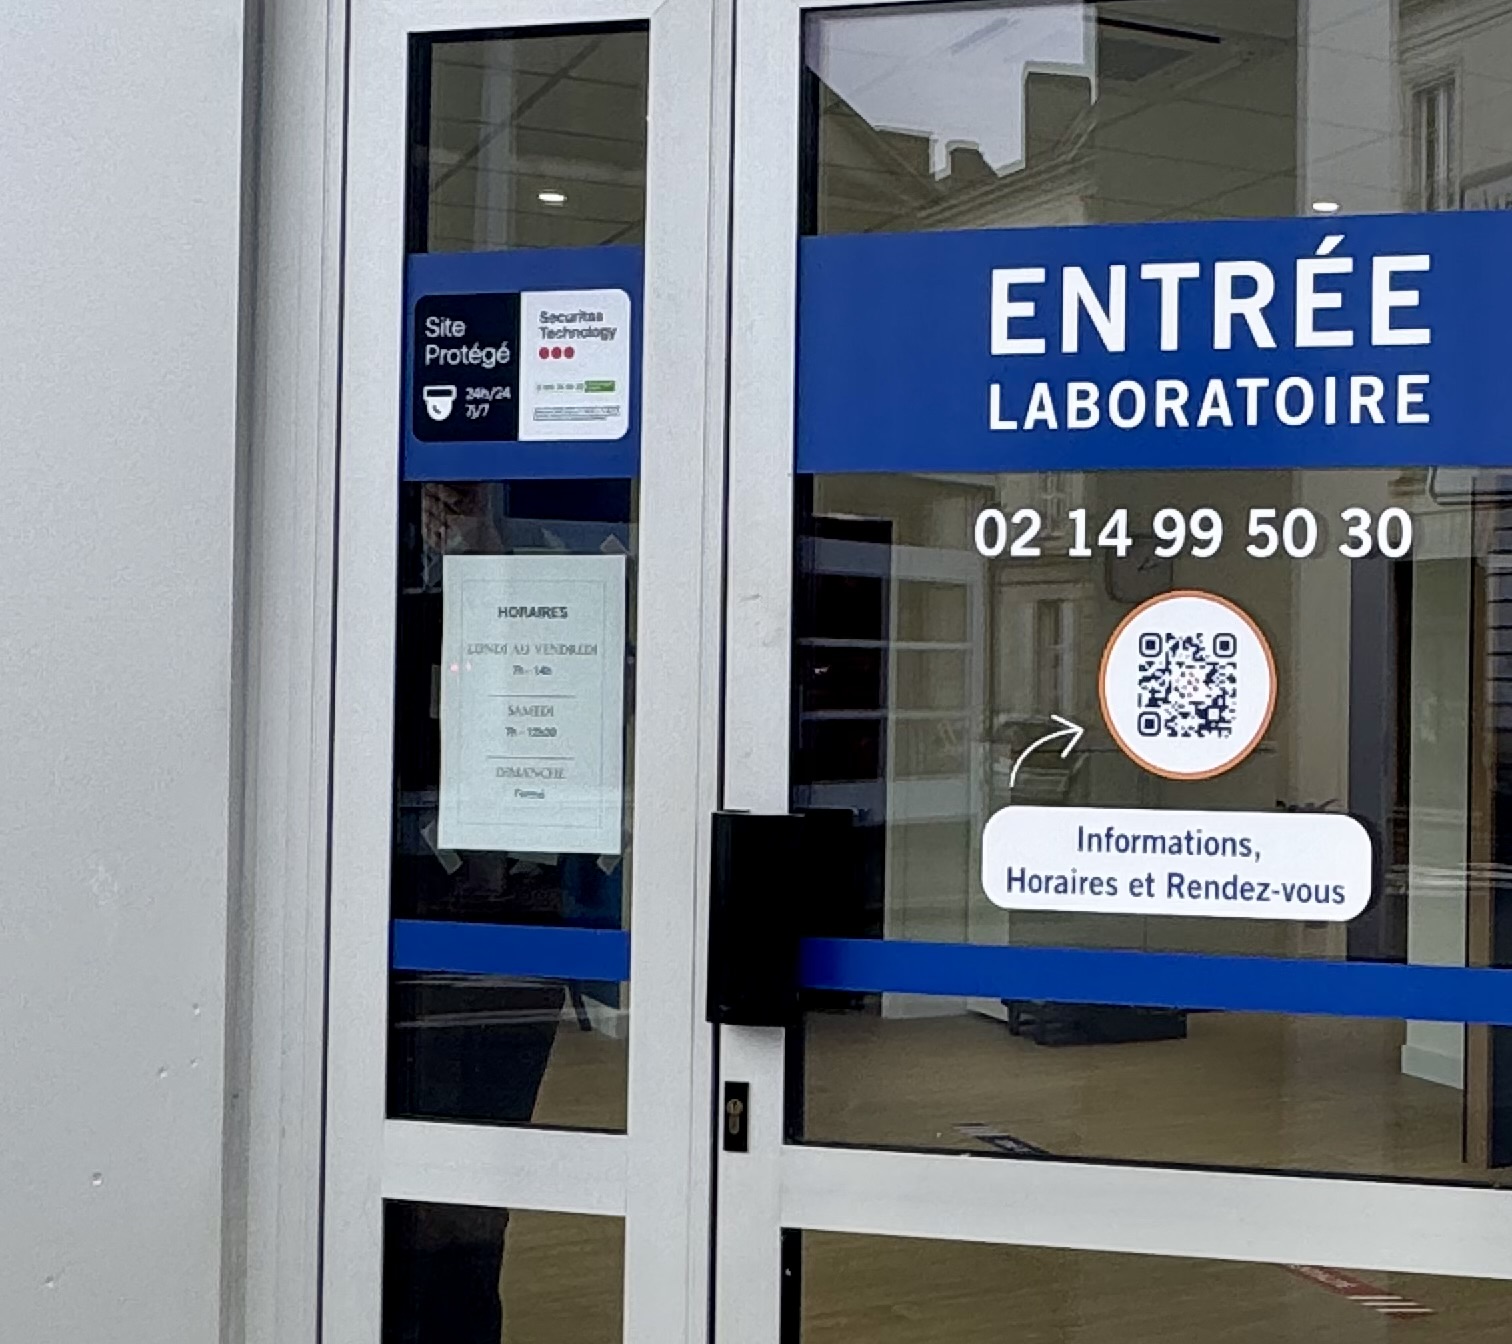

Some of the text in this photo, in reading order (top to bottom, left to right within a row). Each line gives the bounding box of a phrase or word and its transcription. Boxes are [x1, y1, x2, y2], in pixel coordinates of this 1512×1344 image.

[989, 234, 1431, 356] ENTRÉE
[424, 316, 466, 338] Site
[538, 309, 604, 324] Securitas
[538, 325, 618, 342] Technology
[425, 341, 511, 369] Protégé
[989, 374, 1430, 431] LABORATOIRE
[973, 506, 1413, 559] 02 14 99 50 30
[498, 606, 568, 620] HORAIRES
[1077, 825, 1263, 862] Informations,
[1005, 866, 1346, 905] Horaires et Rendez-vous
